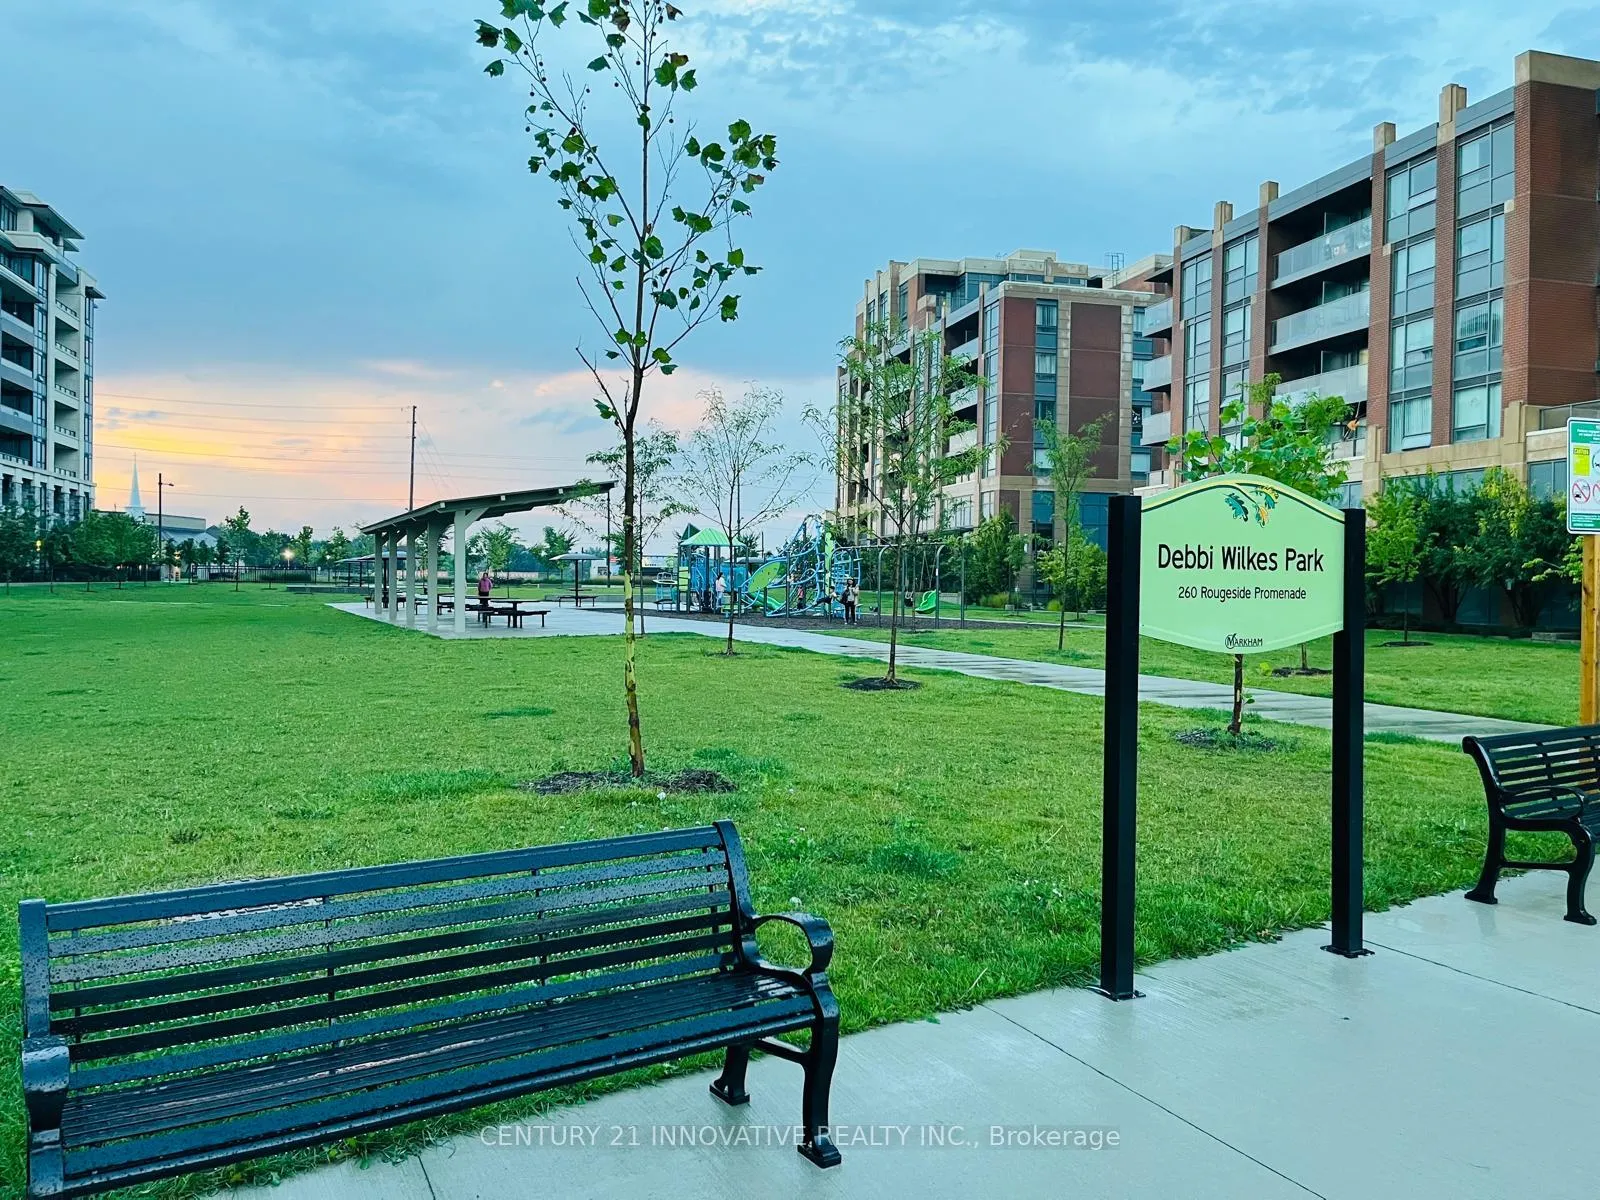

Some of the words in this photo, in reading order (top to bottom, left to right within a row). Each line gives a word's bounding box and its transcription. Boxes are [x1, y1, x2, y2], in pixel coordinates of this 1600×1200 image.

[1158, 544, 1213, 569] Debbi
[1221, 546, 1278, 571] Wilkes
[1285, 548, 1324, 572] Park
[1178, 586, 1197, 599] 260
[1200, 586, 1251, 602] Rougeside
[1254, 587, 1306, 600] Promenade
[1225, 633, 1263, 649] MARKHAM
